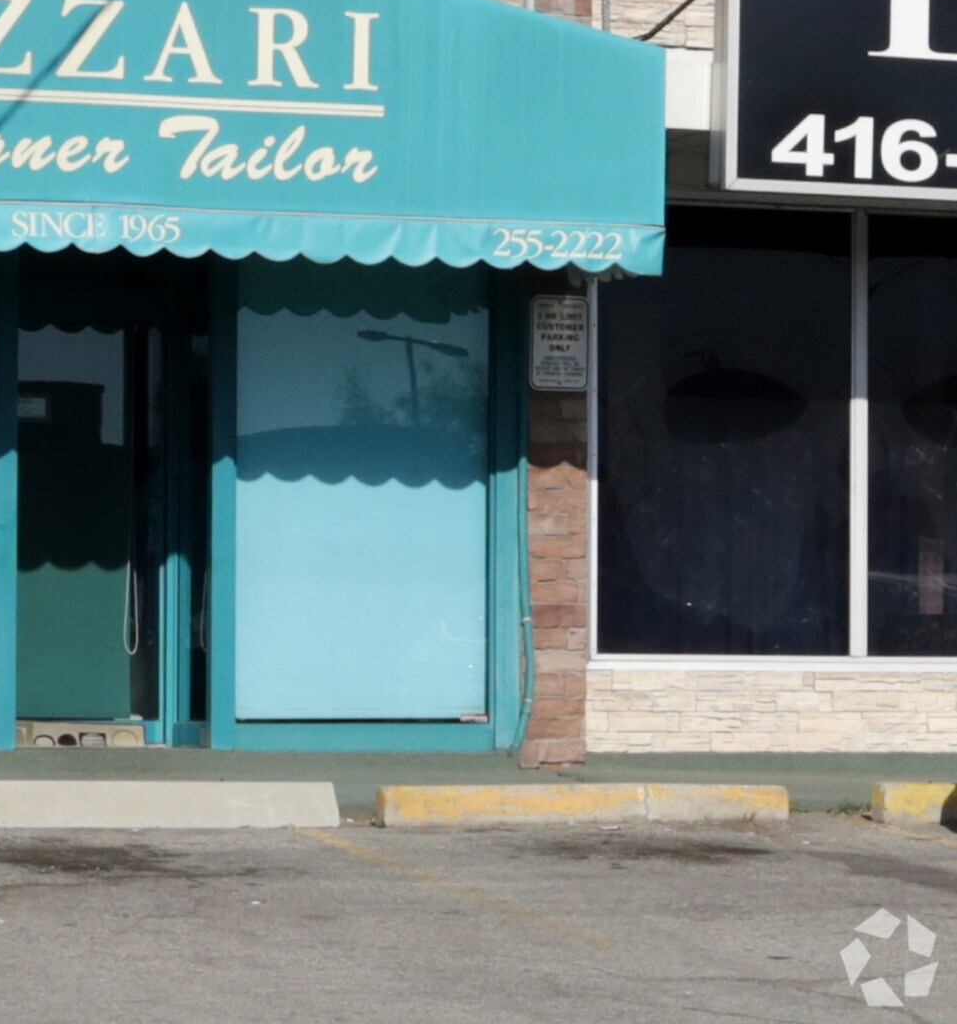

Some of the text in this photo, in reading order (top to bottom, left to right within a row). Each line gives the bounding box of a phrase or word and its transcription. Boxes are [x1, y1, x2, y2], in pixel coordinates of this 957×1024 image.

[158, 114, 379, 184] Tailor
[11, 210, 182, 243] SINCE 1965
[492, 228, 623, 260] 255-2222
